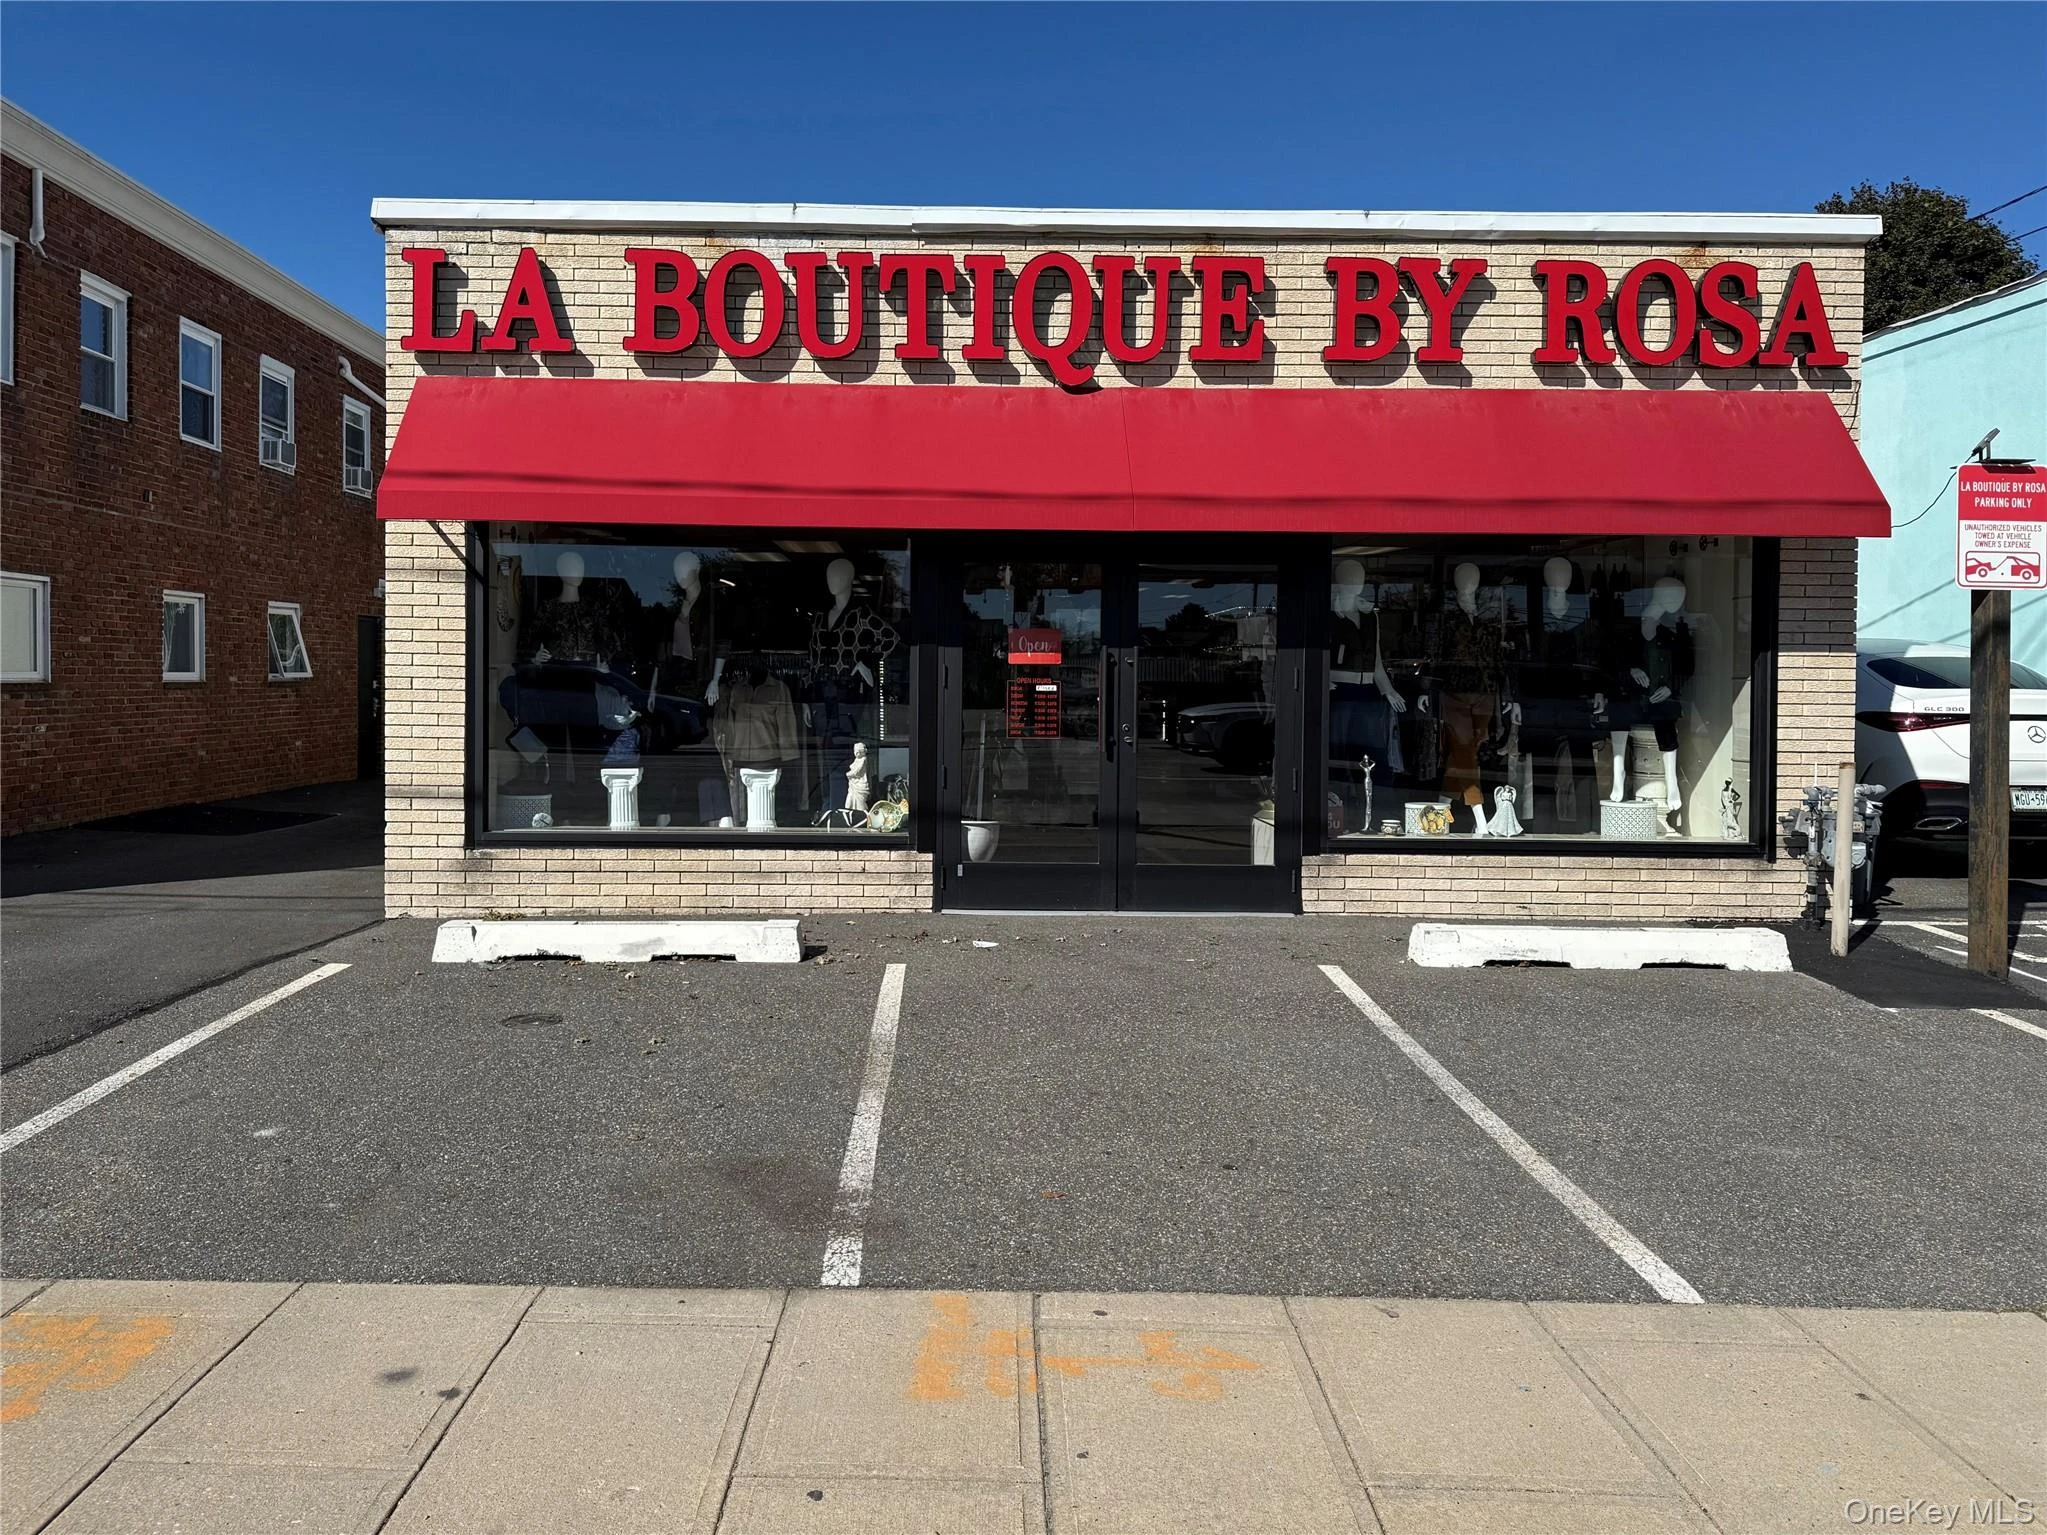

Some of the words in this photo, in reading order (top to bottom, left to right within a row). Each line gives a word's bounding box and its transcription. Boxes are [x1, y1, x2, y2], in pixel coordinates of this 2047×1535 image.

[401, 247, 573, 353] LA
[622, 248, 1266, 387] BOUTIQUE
[1323, 256, 1488, 363] BY
[1533, 258, 1850, 369] ROSA
[1960, 481, 1971, 492] LA
[1972, 481, 2011, 493] BOUTIQUE
[2012, 482, 2023, 493] BY
[2025, 482, 2046, 493] ROSA
[1974, 497, 2010, 508] PARKING
[2011, 497, 2032, 509] ONLY
[1964, 523, 2011, 532] UNAUTHORIZED
[2012, 524, 2042, 532] VEHICLES
[1974, 531, 1995, 540] TOWED
[1996, 532, 2005, 540] AT
[2006, 532, 2032, 540] VEHICLE
[1974, 540, 2002, 548] OWNER'S
[2003, 540, 2031, 549] EXPENSE
[1018, 635, 1052, 658] Open
